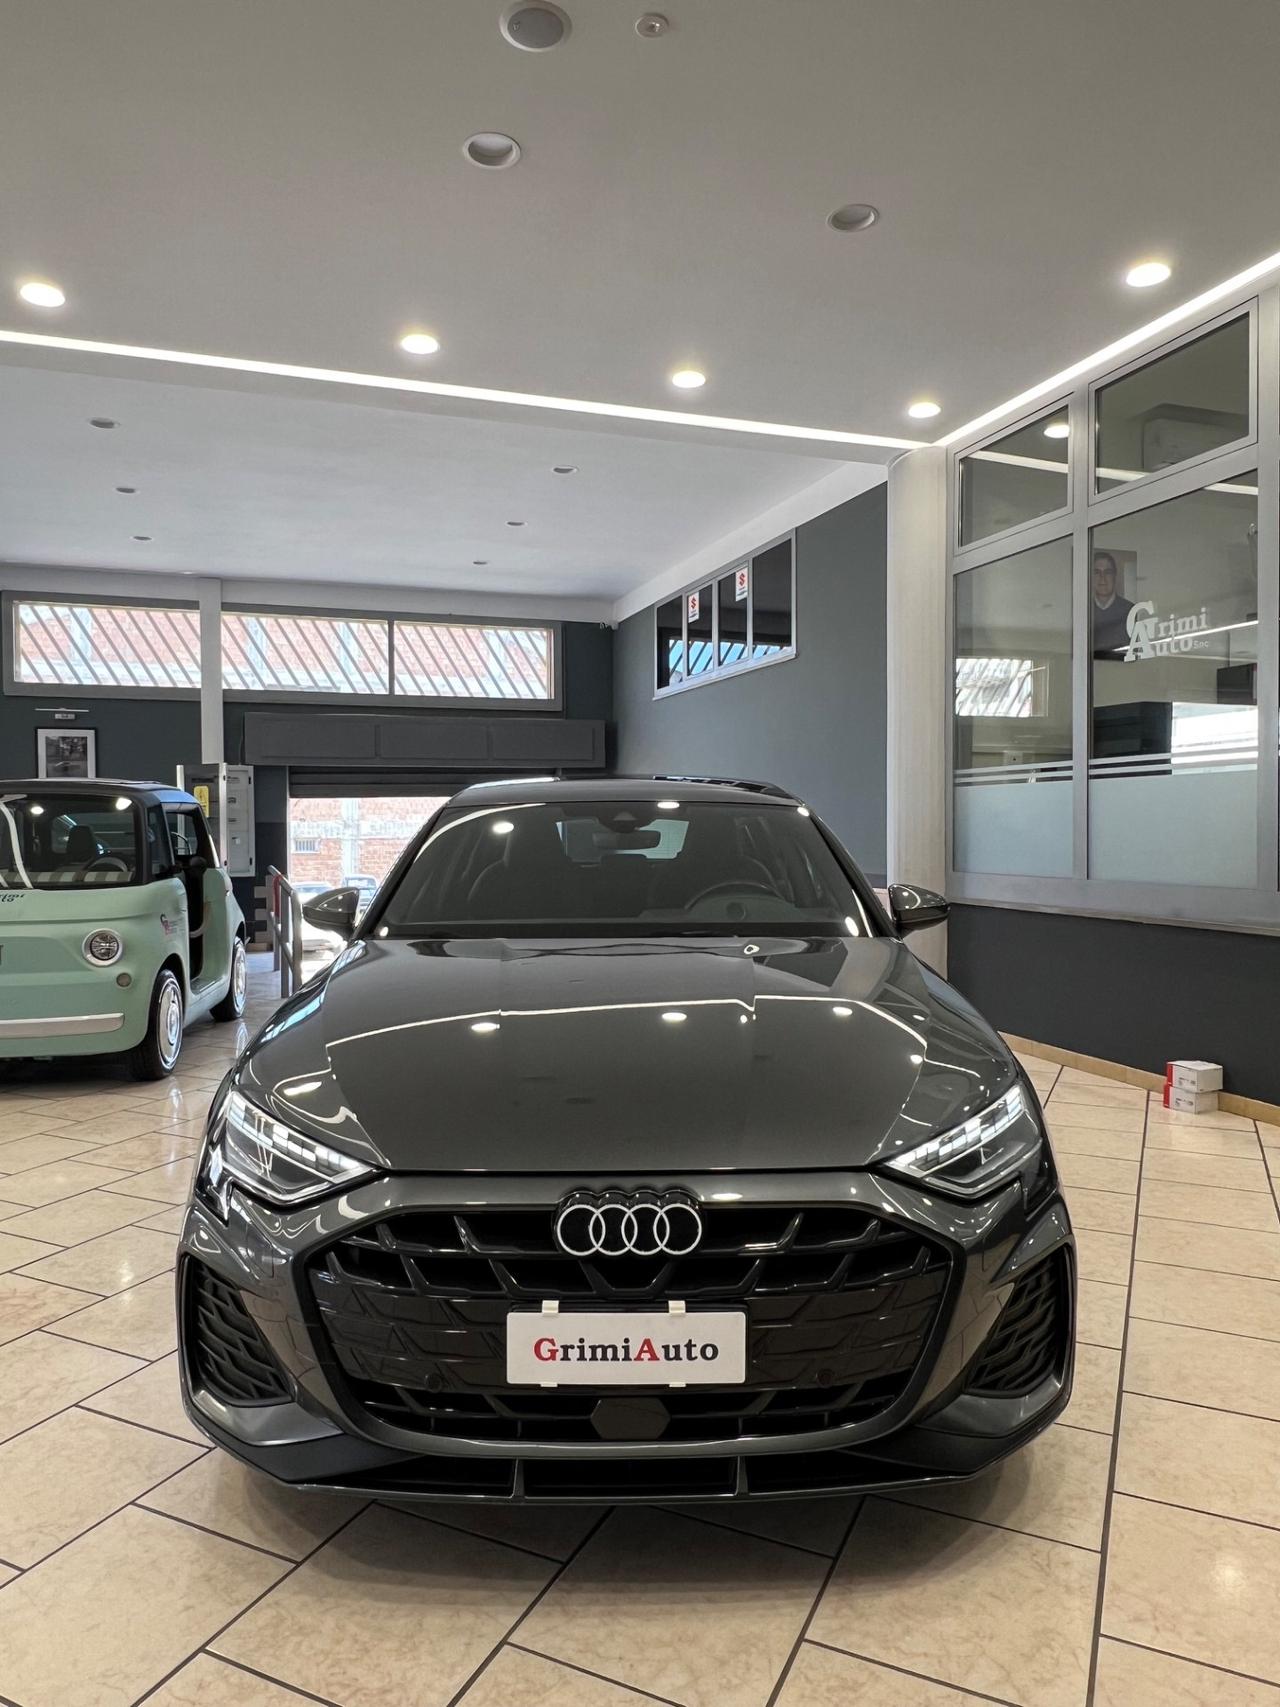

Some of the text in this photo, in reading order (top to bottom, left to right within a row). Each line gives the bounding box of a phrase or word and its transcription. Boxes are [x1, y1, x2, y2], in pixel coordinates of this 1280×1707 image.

[1126, 600, 1207, 639] Grimi
[1124, 621, 1193, 662] Auto
[533, 1337, 719, 1362] GrimiAuto
